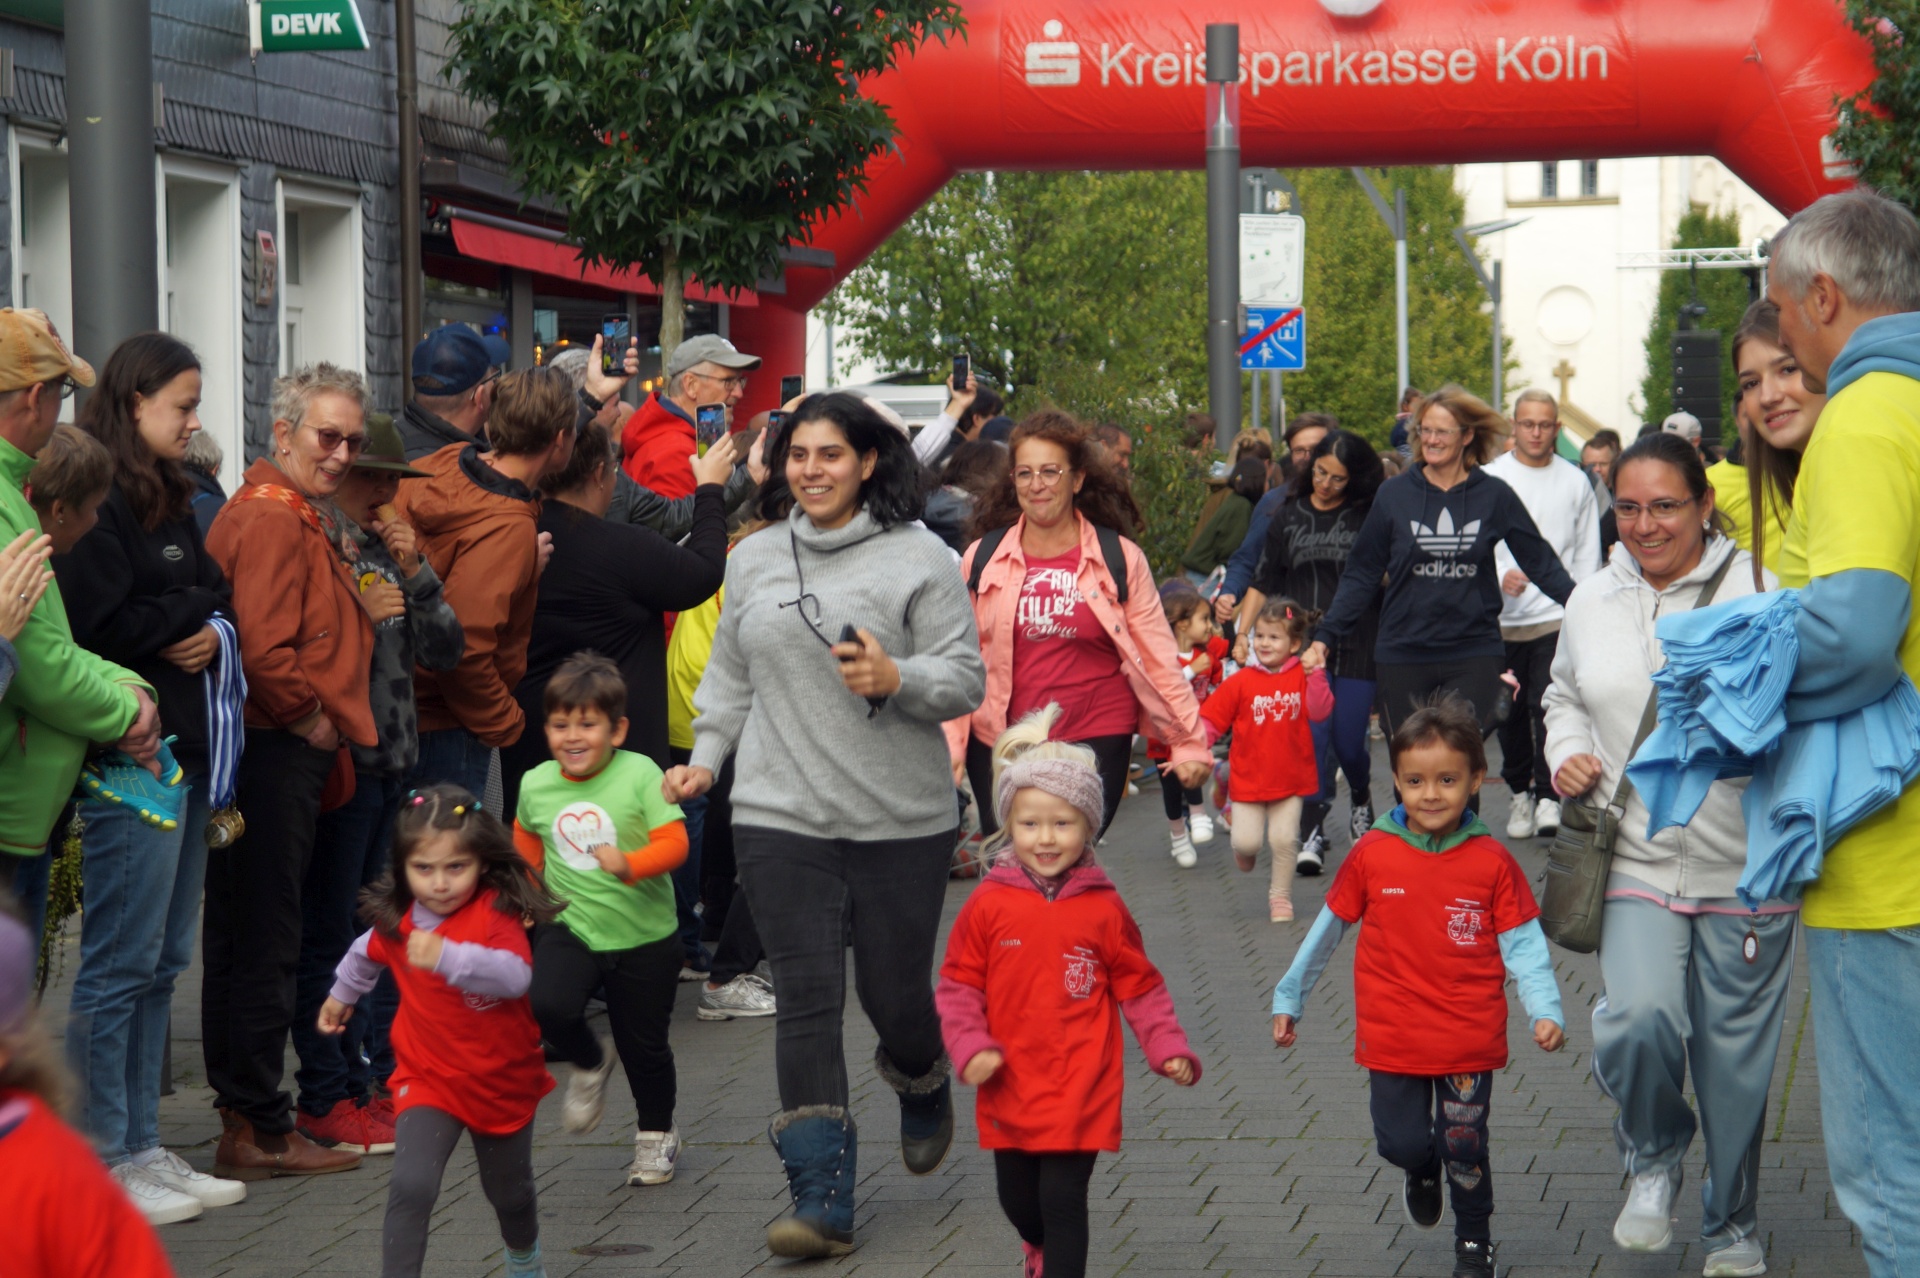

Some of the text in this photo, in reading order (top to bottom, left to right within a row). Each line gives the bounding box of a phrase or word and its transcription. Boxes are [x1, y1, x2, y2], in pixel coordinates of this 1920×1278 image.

[271, 12, 342, 36] DEVK
[1496, 35, 1608, 82] Köln
[1412, 560, 1478, 578] adidas
